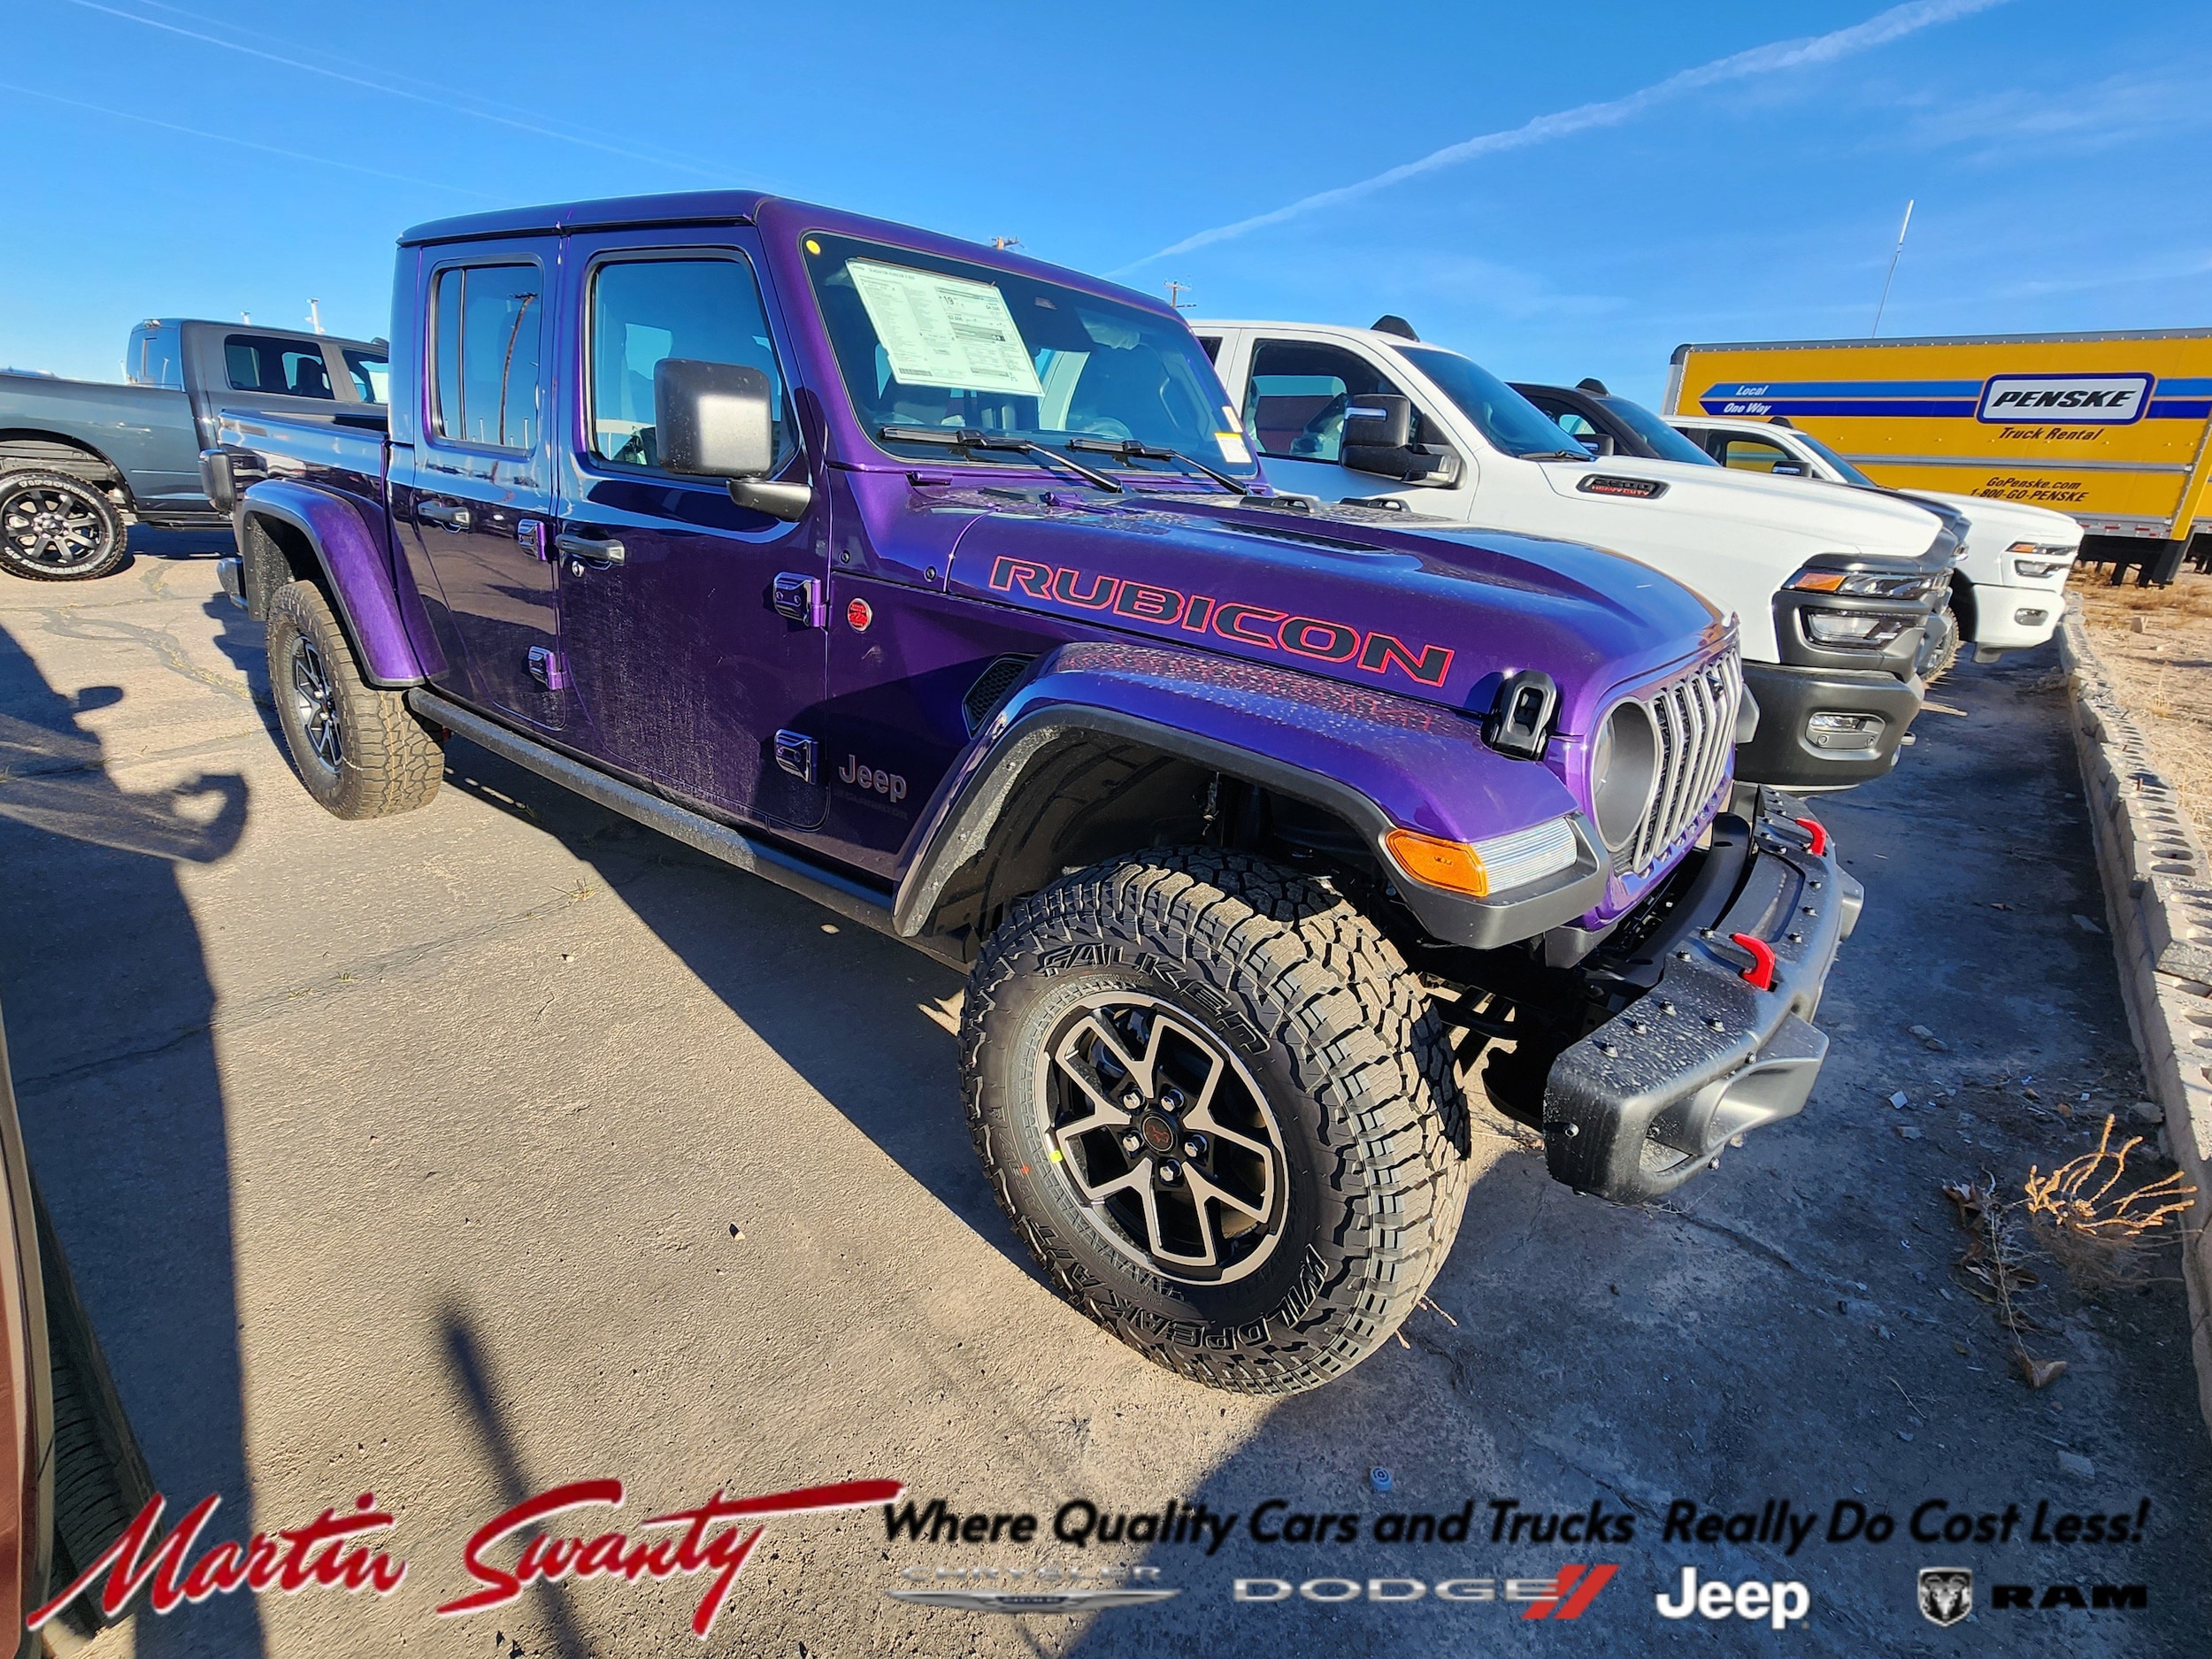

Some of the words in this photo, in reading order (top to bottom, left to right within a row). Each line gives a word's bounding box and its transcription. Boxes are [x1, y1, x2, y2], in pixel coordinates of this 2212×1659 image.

[1735, 384, 1769, 398] Local
[1991, 389, 2137, 409] PENSKE
[1724, 402, 1745, 415] One
[1747, 402, 1772, 417] Way
[1997, 426, 2045, 442] Truck
[2048, 427, 2103, 442] Rental
[1985, 476, 2083, 492] GoPenske.com
[1970, 488, 2089, 503] 1-800-GO-PENSKE
[988, 555, 1455, 687] RUBICON
[838, 754, 907, 803] Jeep
[1038, 941, 1271, 1055] FALKEN
[1098, 1243, 1329, 1351] WILDPEAK
